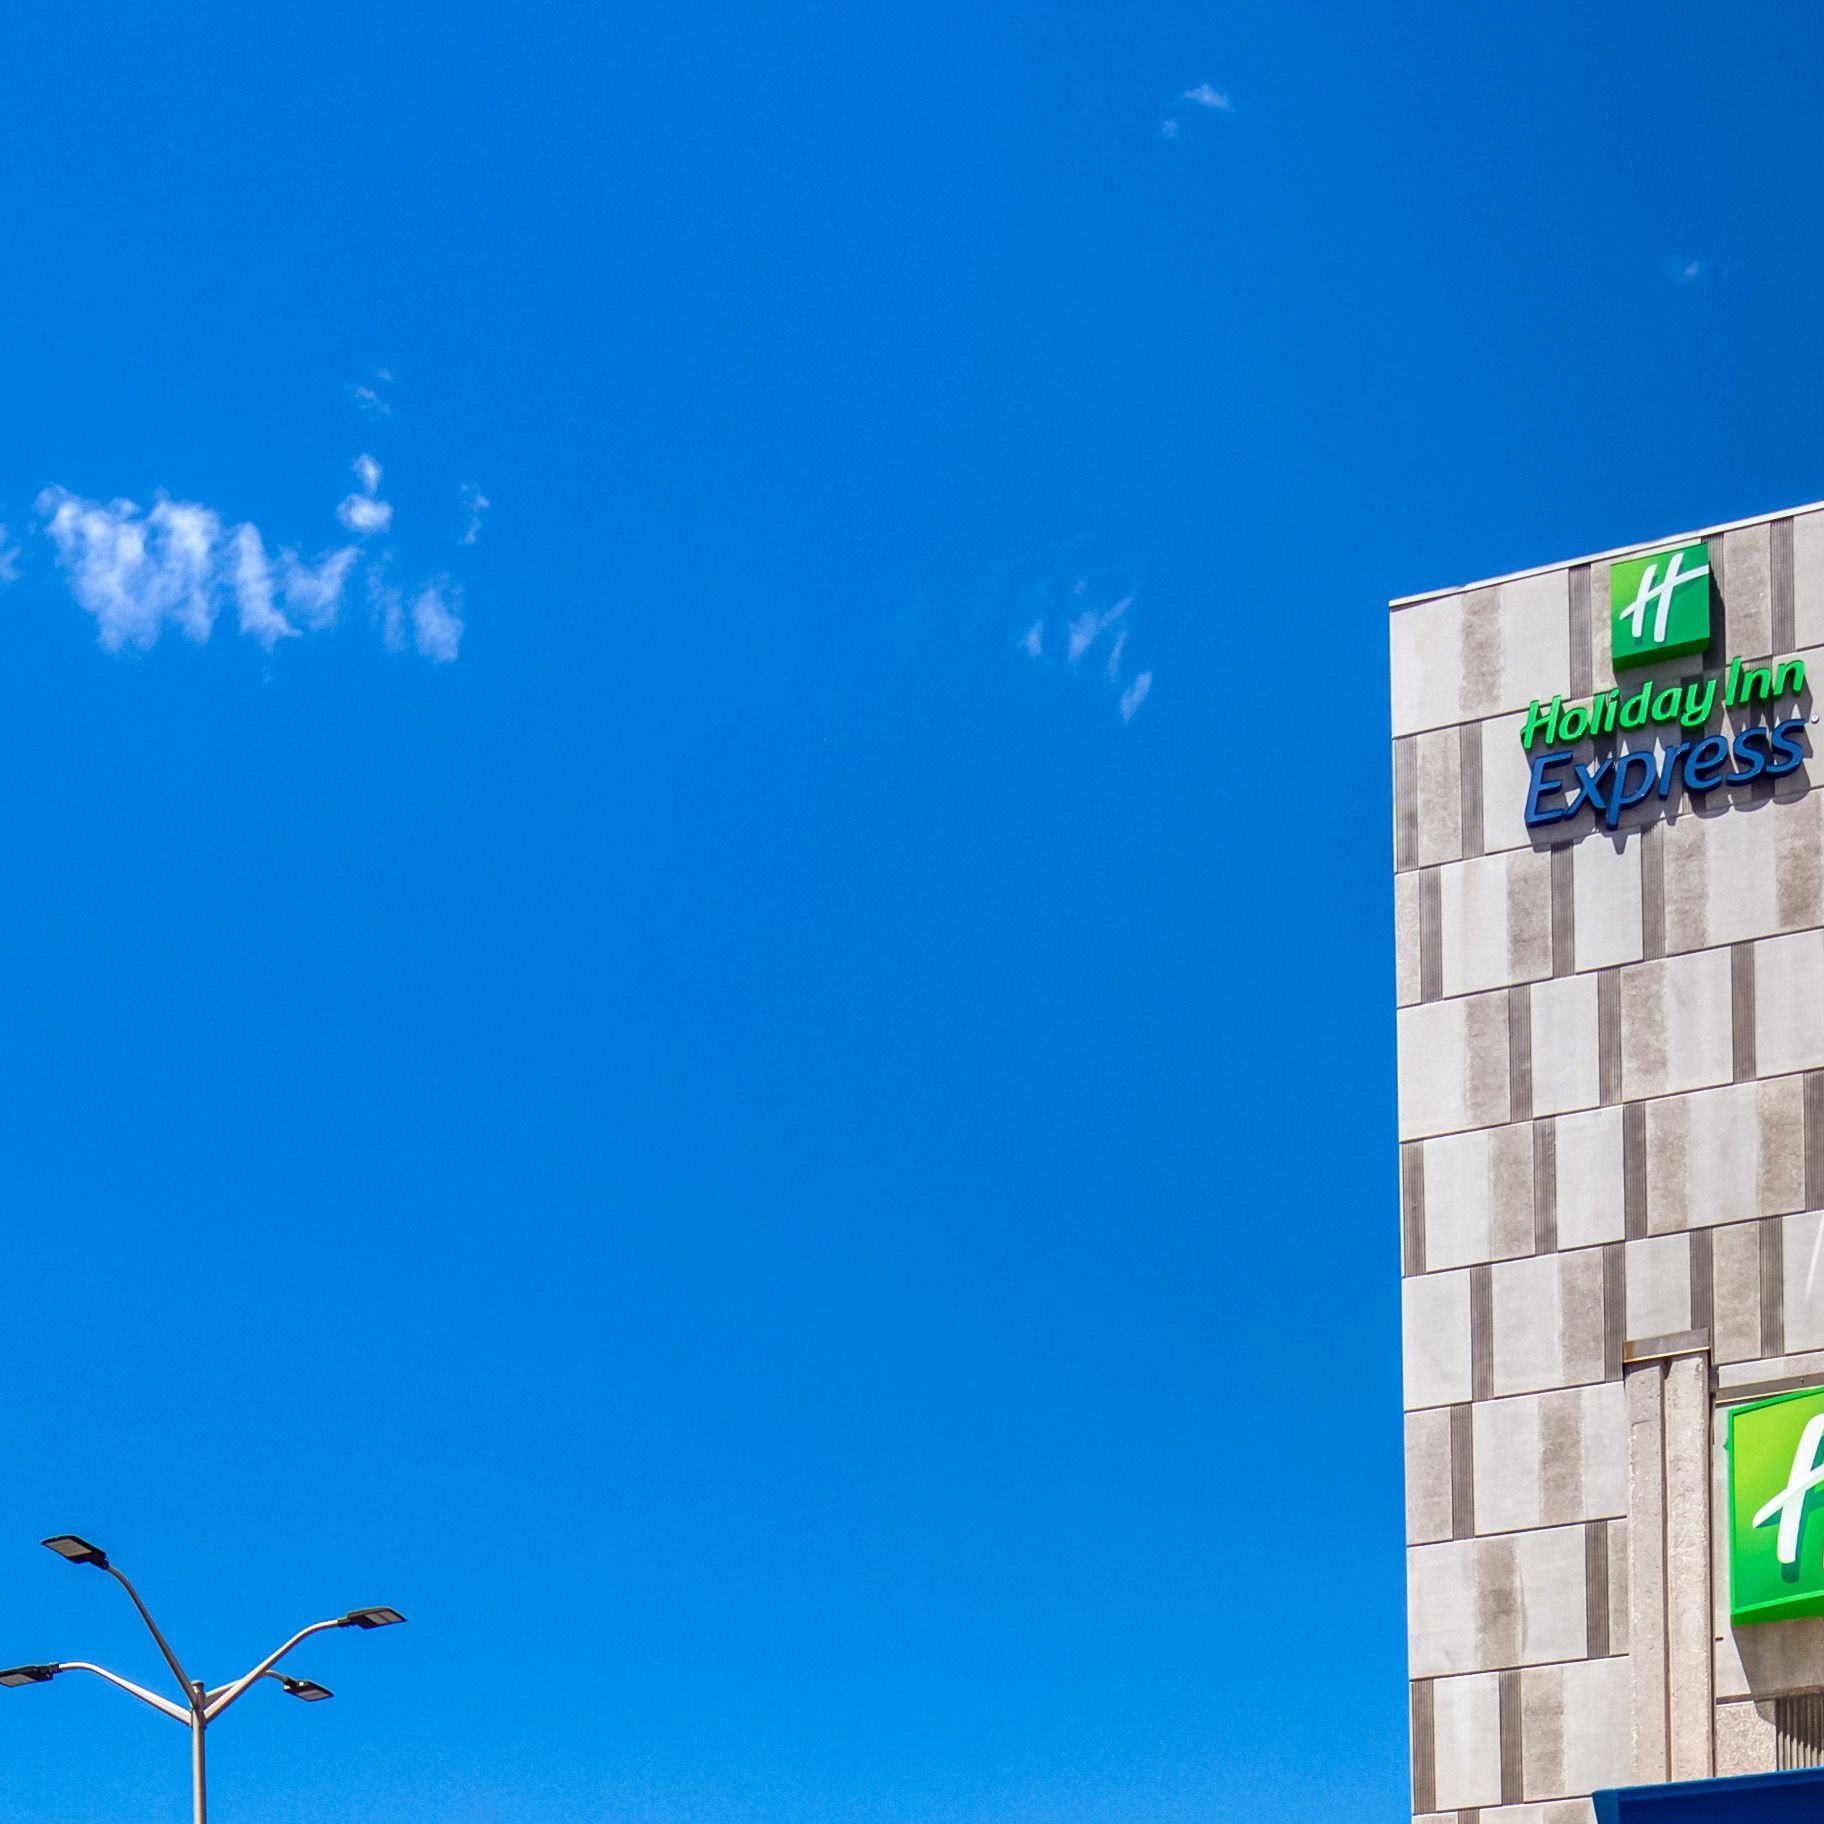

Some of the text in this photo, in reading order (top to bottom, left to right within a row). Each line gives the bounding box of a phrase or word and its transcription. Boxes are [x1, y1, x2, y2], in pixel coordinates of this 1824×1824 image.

[1520, 656, 1805, 750] Holiday Inn
[1524, 718, 1808, 830] Express
